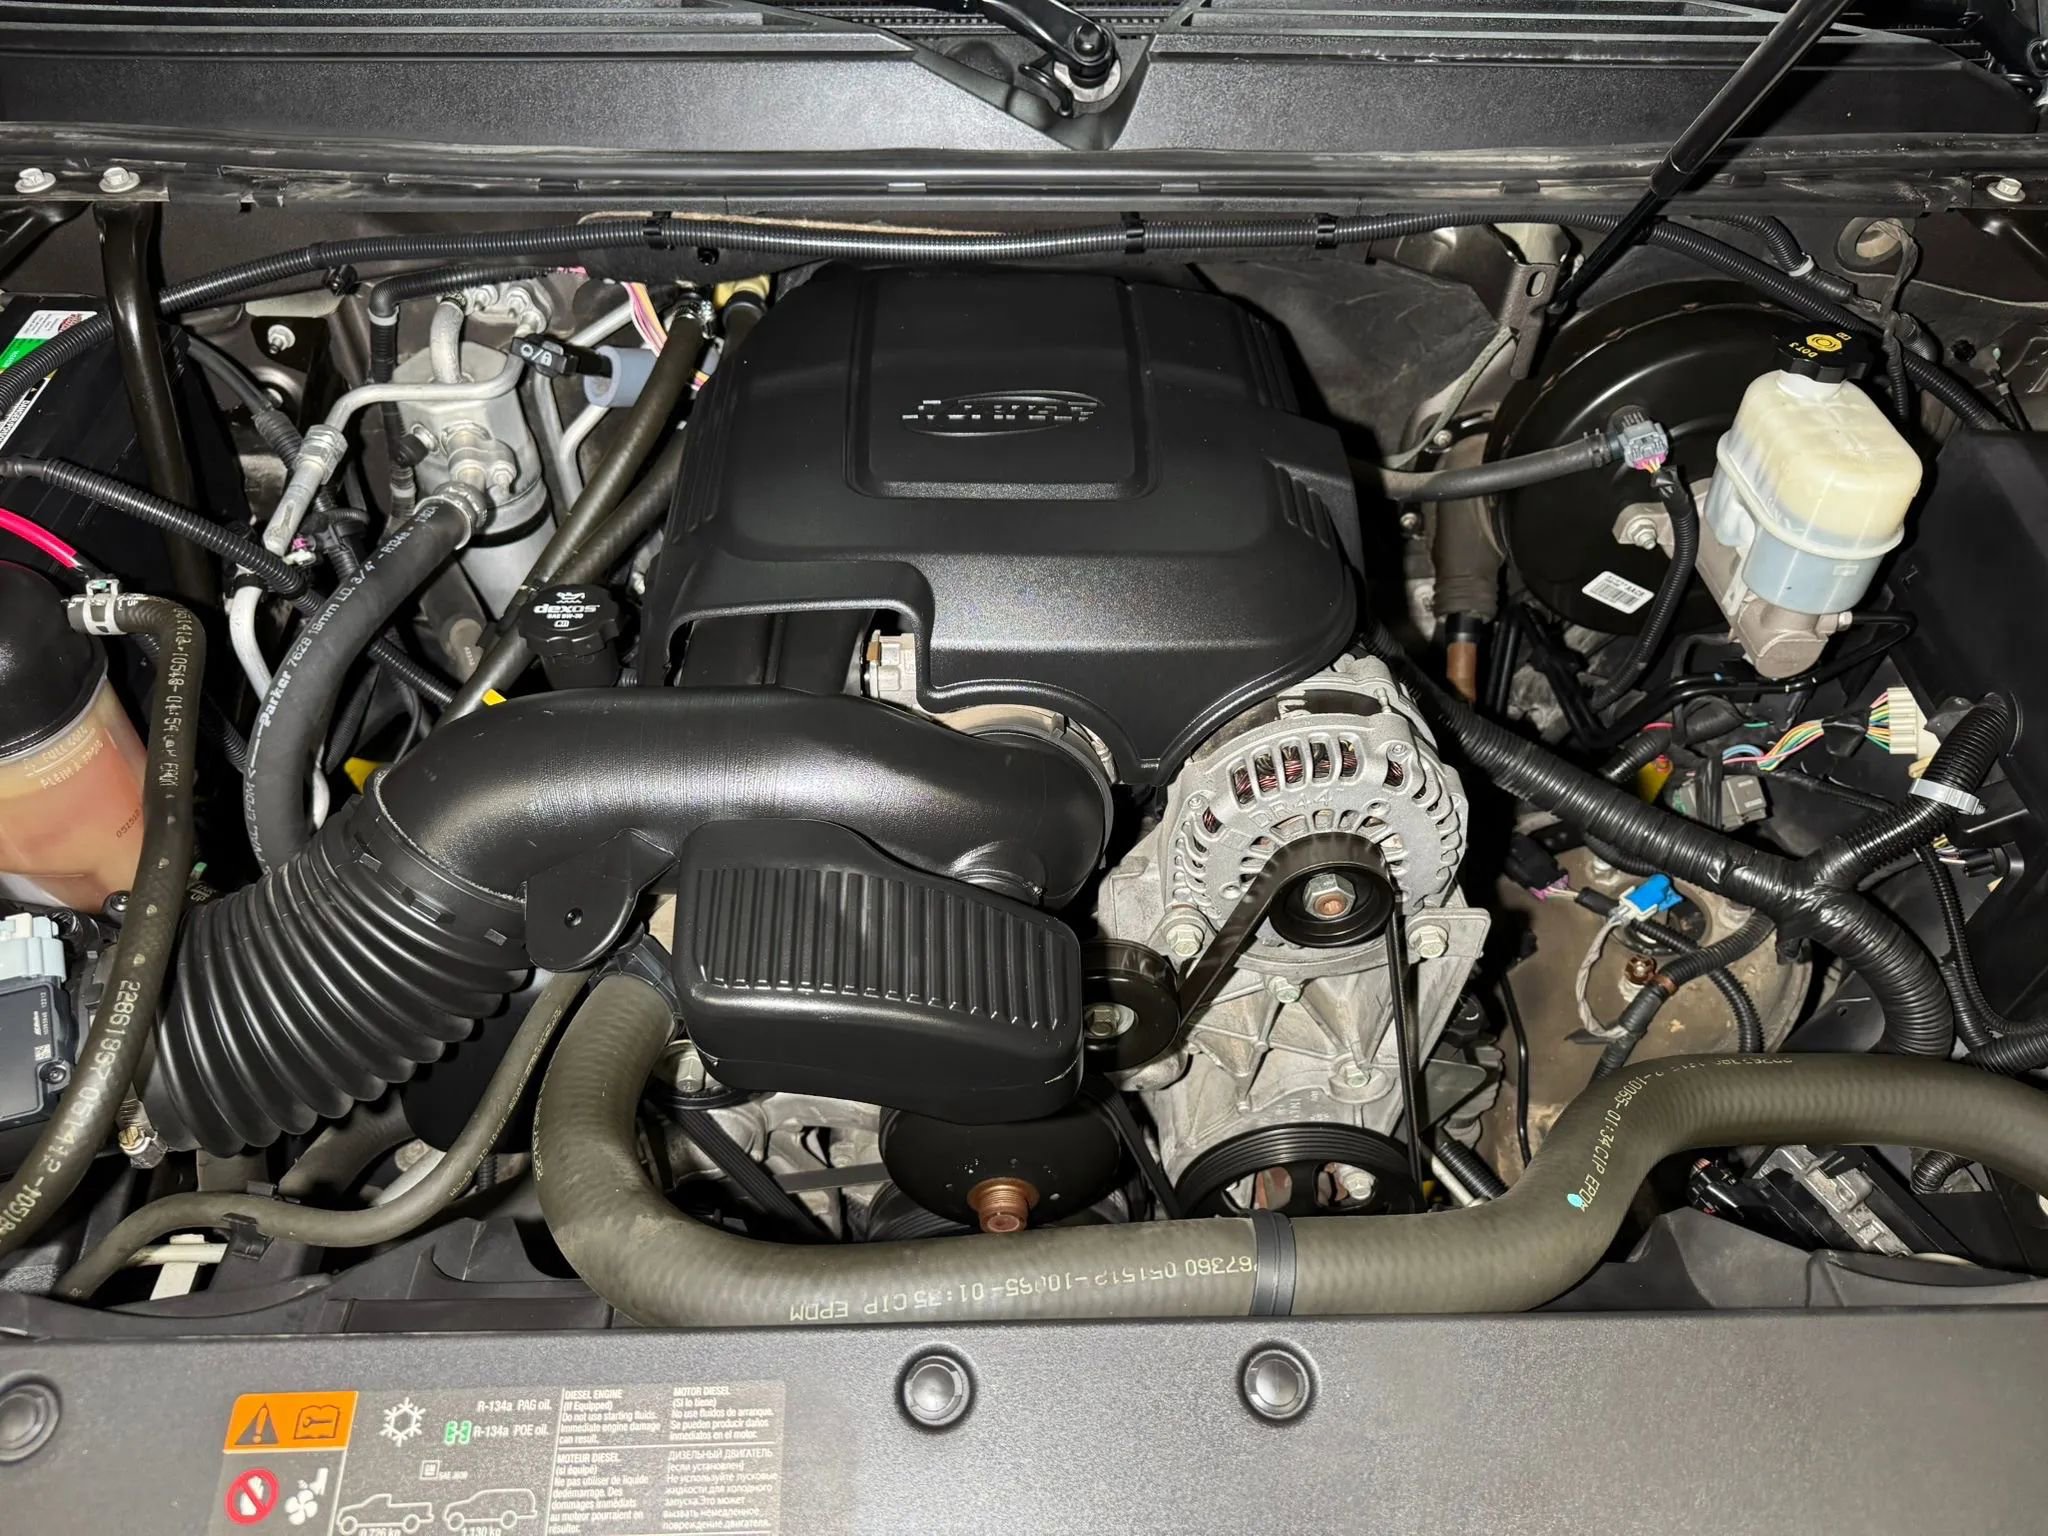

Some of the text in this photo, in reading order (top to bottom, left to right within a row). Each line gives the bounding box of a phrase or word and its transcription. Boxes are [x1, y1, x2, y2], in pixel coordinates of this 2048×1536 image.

[533, 603, 600, 614] dexos
[259, 668, 292, 728] Parker
[1185, 1255, 1258, 1278] 67360
[864, 1293, 906, 1314] CIP
[790, 1299, 849, 1321] EPDM
[565, 1390, 623, 1400] DIESEL ENGINE
[673, 1386, 731, 1396] MOTOR DIESEL
[477, 1399, 552, 1412] R-134a PAG oil.
[574, 1400, 612, 1411] Equipped)
[562, 1410, 658, 1422] Do not use starting fluids.
[671, 1410, 682, 1418] No
[684, 1410, 698, 1418] use
[700, 1408, 725, 1417] fluidos
[726, 1408, 736, 1416] de
[560, 1422, 661, 1433] Immediate engine damage
[671, 1421, 681, 1429] Se
[682, 1419, 711, 1430] pueden
[712, 1418, 744, 1430] producir
[473, 1424, 549, 1437] R-134a POE oil.
[713, 1431, 723, 1440] en
[725, 1430, 732, 1439] el
[560, 1434, 600, 1444] can result.
[557, 1453, 620, 1463] MOTEUR DIESEL
[669, 1448, 773, 1461] ДИЗЕЛЬНЫЙ ДВИГАТЕЛЬ
[554, 1478, 565, 1486] Ne
[566, 1478, 581, 1487] pas
[610, 1476, 620, 1485] de
[622, 1475, 648, 1485] liquide
[607, 1487, 623, 1496] Des
[552, 1500, 594, 1511] dommages
[550, 1513, 561, 1521] au
[561, 1512, 590, 1521] moteur
[633, 1511, 644, 1519] en
